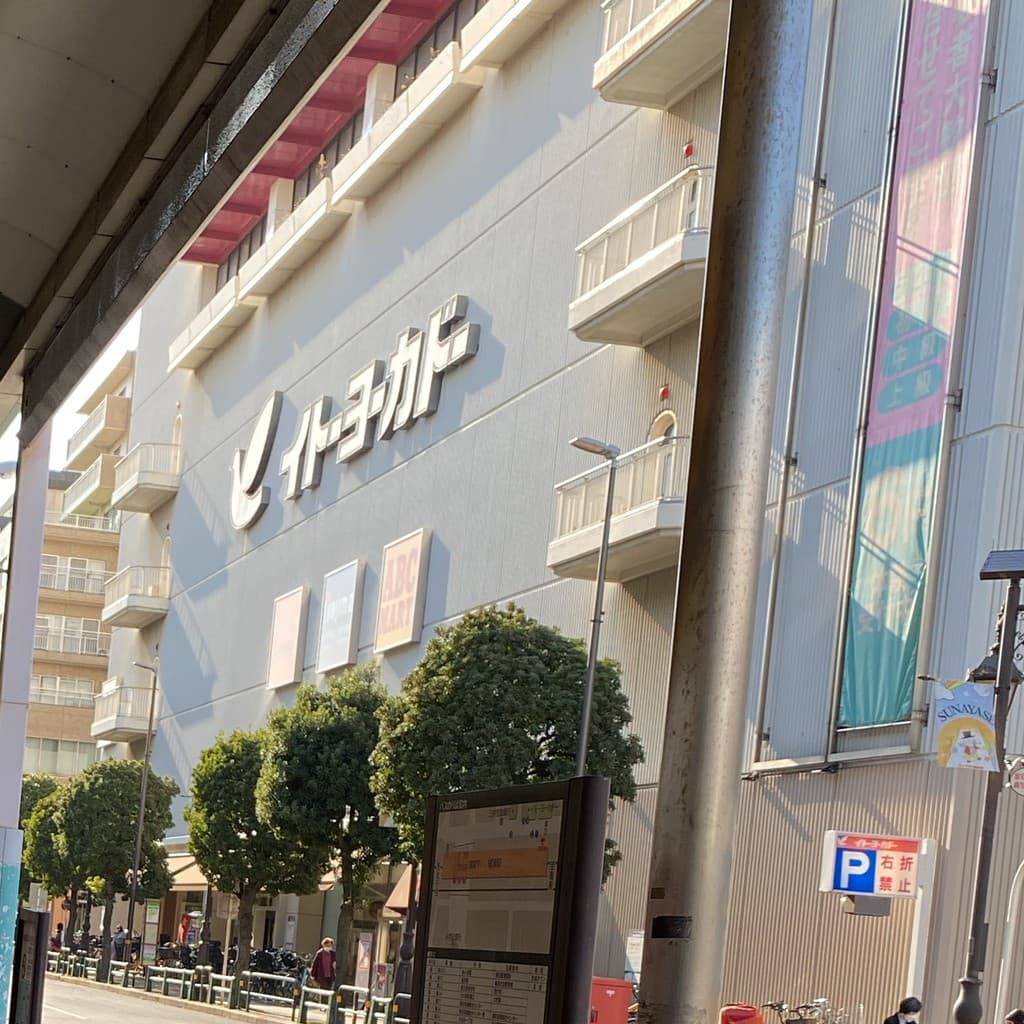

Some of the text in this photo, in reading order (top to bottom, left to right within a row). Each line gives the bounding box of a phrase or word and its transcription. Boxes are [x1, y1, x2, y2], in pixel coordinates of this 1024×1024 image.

[384, 548, 418, 601] ABC
[840, 850, 870, 889] P
[881, 855, 914, 872] 右折
[879, 876, 911, 893] 禁止
